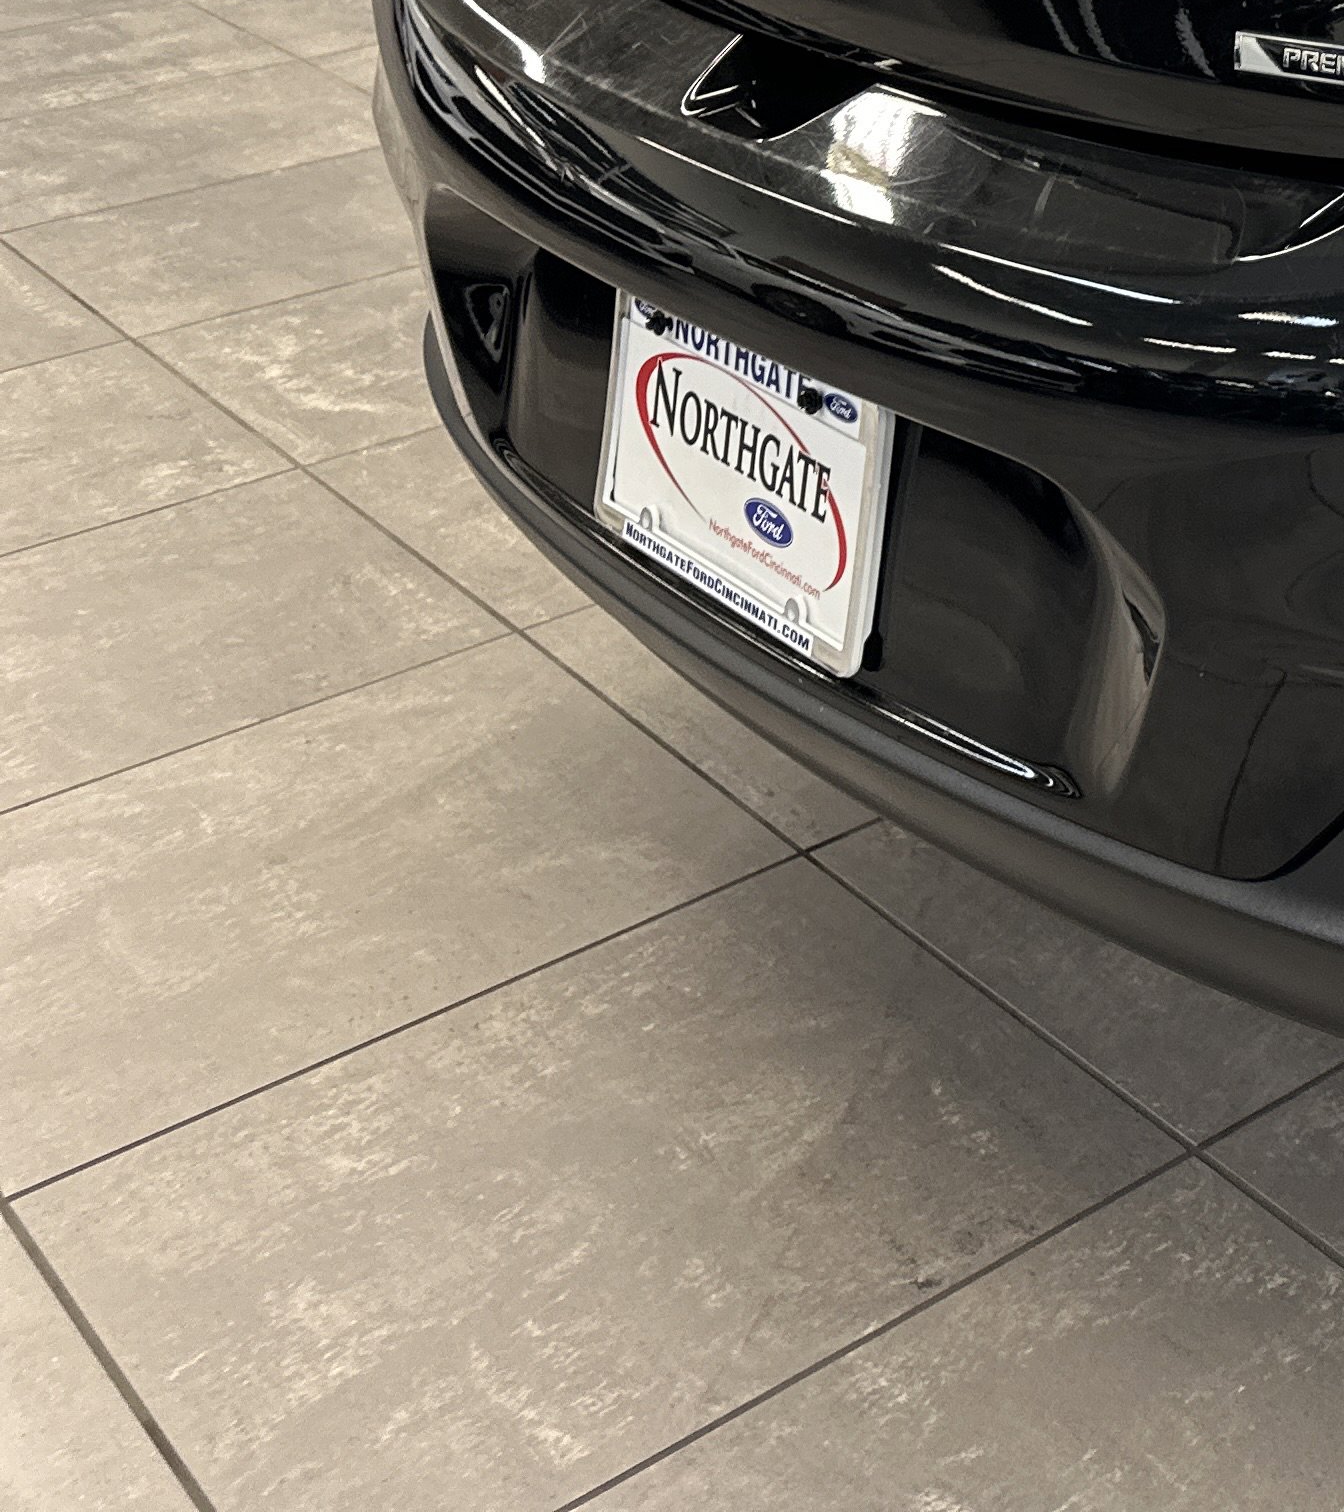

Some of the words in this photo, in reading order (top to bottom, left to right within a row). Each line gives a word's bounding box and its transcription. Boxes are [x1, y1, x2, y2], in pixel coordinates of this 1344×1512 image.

[827, 395, 854, 421] Ford
[650, 359, 831, 523] NORTHGATE
[750, 502, 787, 543] Ford
